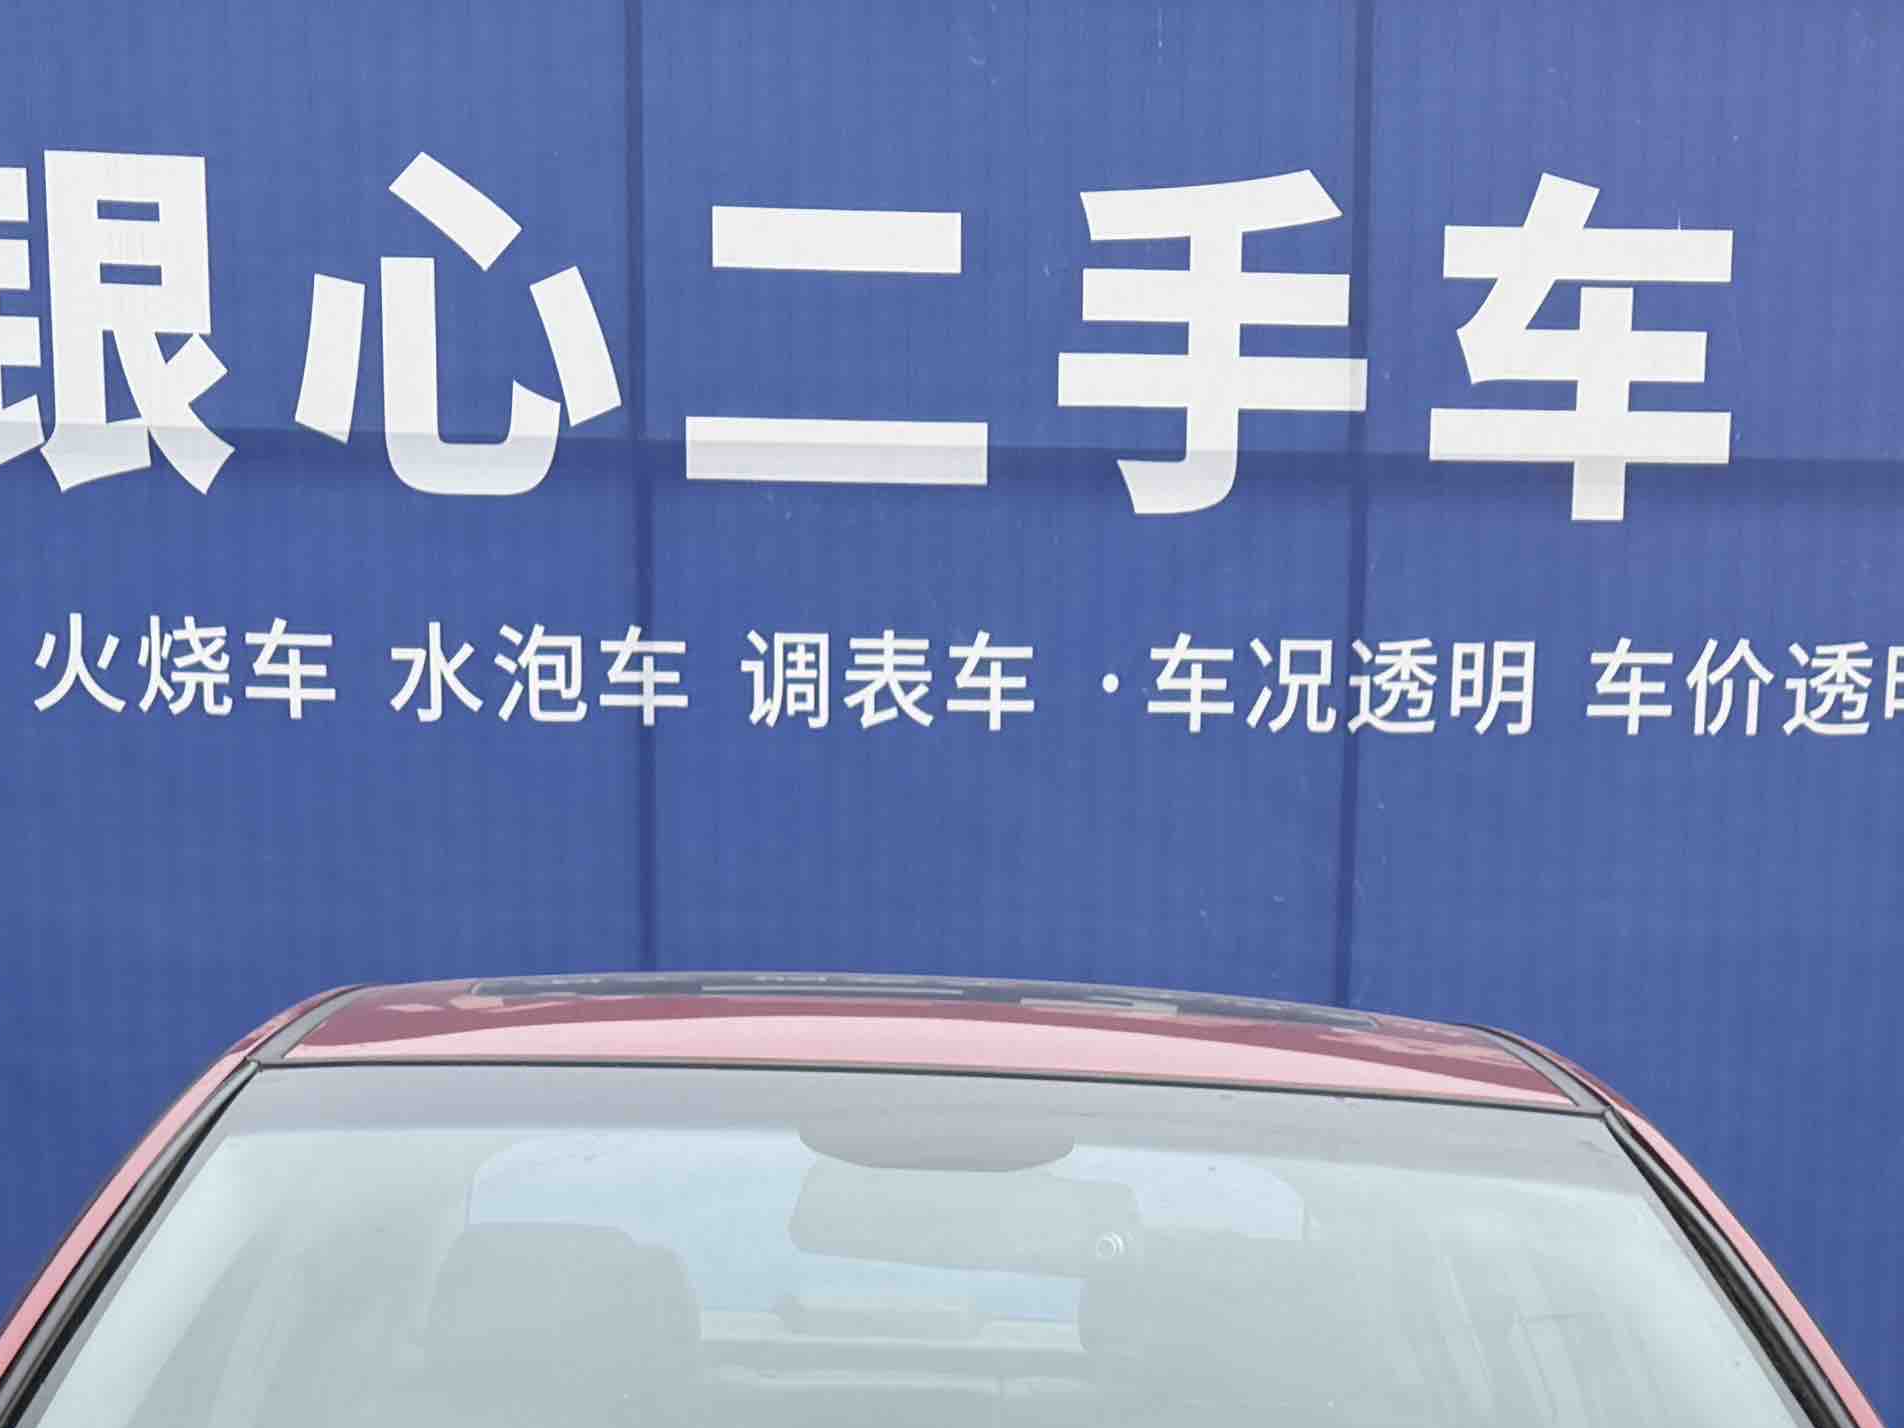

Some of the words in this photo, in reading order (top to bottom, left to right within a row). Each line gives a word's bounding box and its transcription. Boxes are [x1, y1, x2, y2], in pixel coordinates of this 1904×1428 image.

[34, 613, 336, 719] 火烧车
[390, 621, 689, 726] 水泡车
[740, 629, 1035, 731] 调表车
